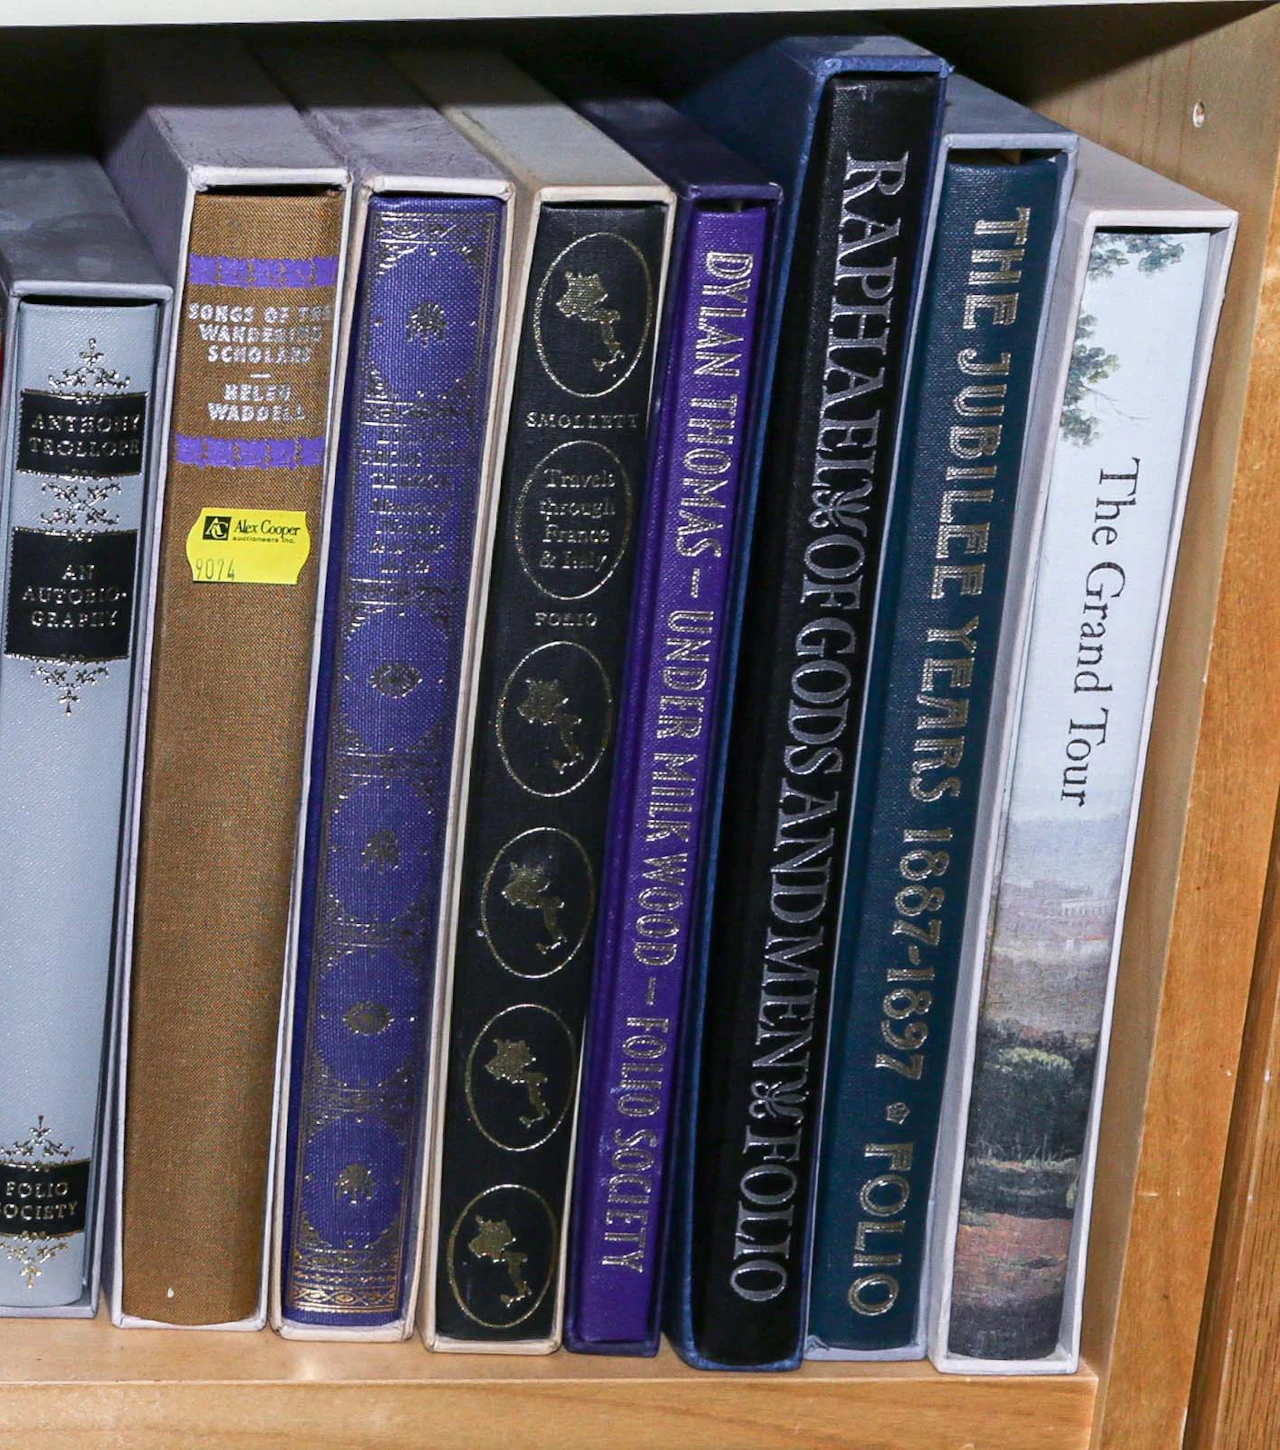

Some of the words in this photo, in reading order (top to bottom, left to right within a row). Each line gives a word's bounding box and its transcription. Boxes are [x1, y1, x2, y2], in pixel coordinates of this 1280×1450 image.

[188, 302, 255, 323] SONGS
[264, 306, 291, 323] OF
[693, 250, 754, 379] DYLAN
[811, 150, 909, 487] RAPHAEL
[962, 205, 1031, 331] THE
[207, 344, 312, 364] SCHOLARS
[223, 383, 291, 402] HELEN
[30, 412, 140, 433] ANTHONY
[525, 411, 641, 429] SMOLLETT
[542, 467, 616, 488] Travels
[675, 394, 739, 560] THOMAS
[930, 349, 1013, 600] JUBILEE
[1090, 456, 1142, 547] The
[61, 564, 96, 581] AN
[195, 558, 235, 581] 9074
[234, 519, 259, 534] Alex
[260, 519, 301, 538] Cooper
[542, 523, 610, 543] France
[799, 534, 865, 611] OF
[534, 611, 598, 627] FOLIO
[1072, 559, 1127, 695] Grand
[657, 609, 715, 740] UNDER
[783, 616, 858, 776] GODS
[909, 616, 980, 805] YEARS
[645, 751, 699, 844] MILK
[1059, 706, 1110, 809] Tour
[768, 777, 840, 924] AND
[632, 853, 689, 968] WOOD
[874, 826, 954, 1082] 1887-1897
[751, 926, 826, 1073] MEN
[615, 1015, 671, 1119] FOLIO
[5, 1180, 69, 1198] FOLIO
[601, 1128, 659, 1274] SOCIETY
[729, 1124, 804, 1303] FOLIO
[847, 1141, 915, 1318] FOLIO
